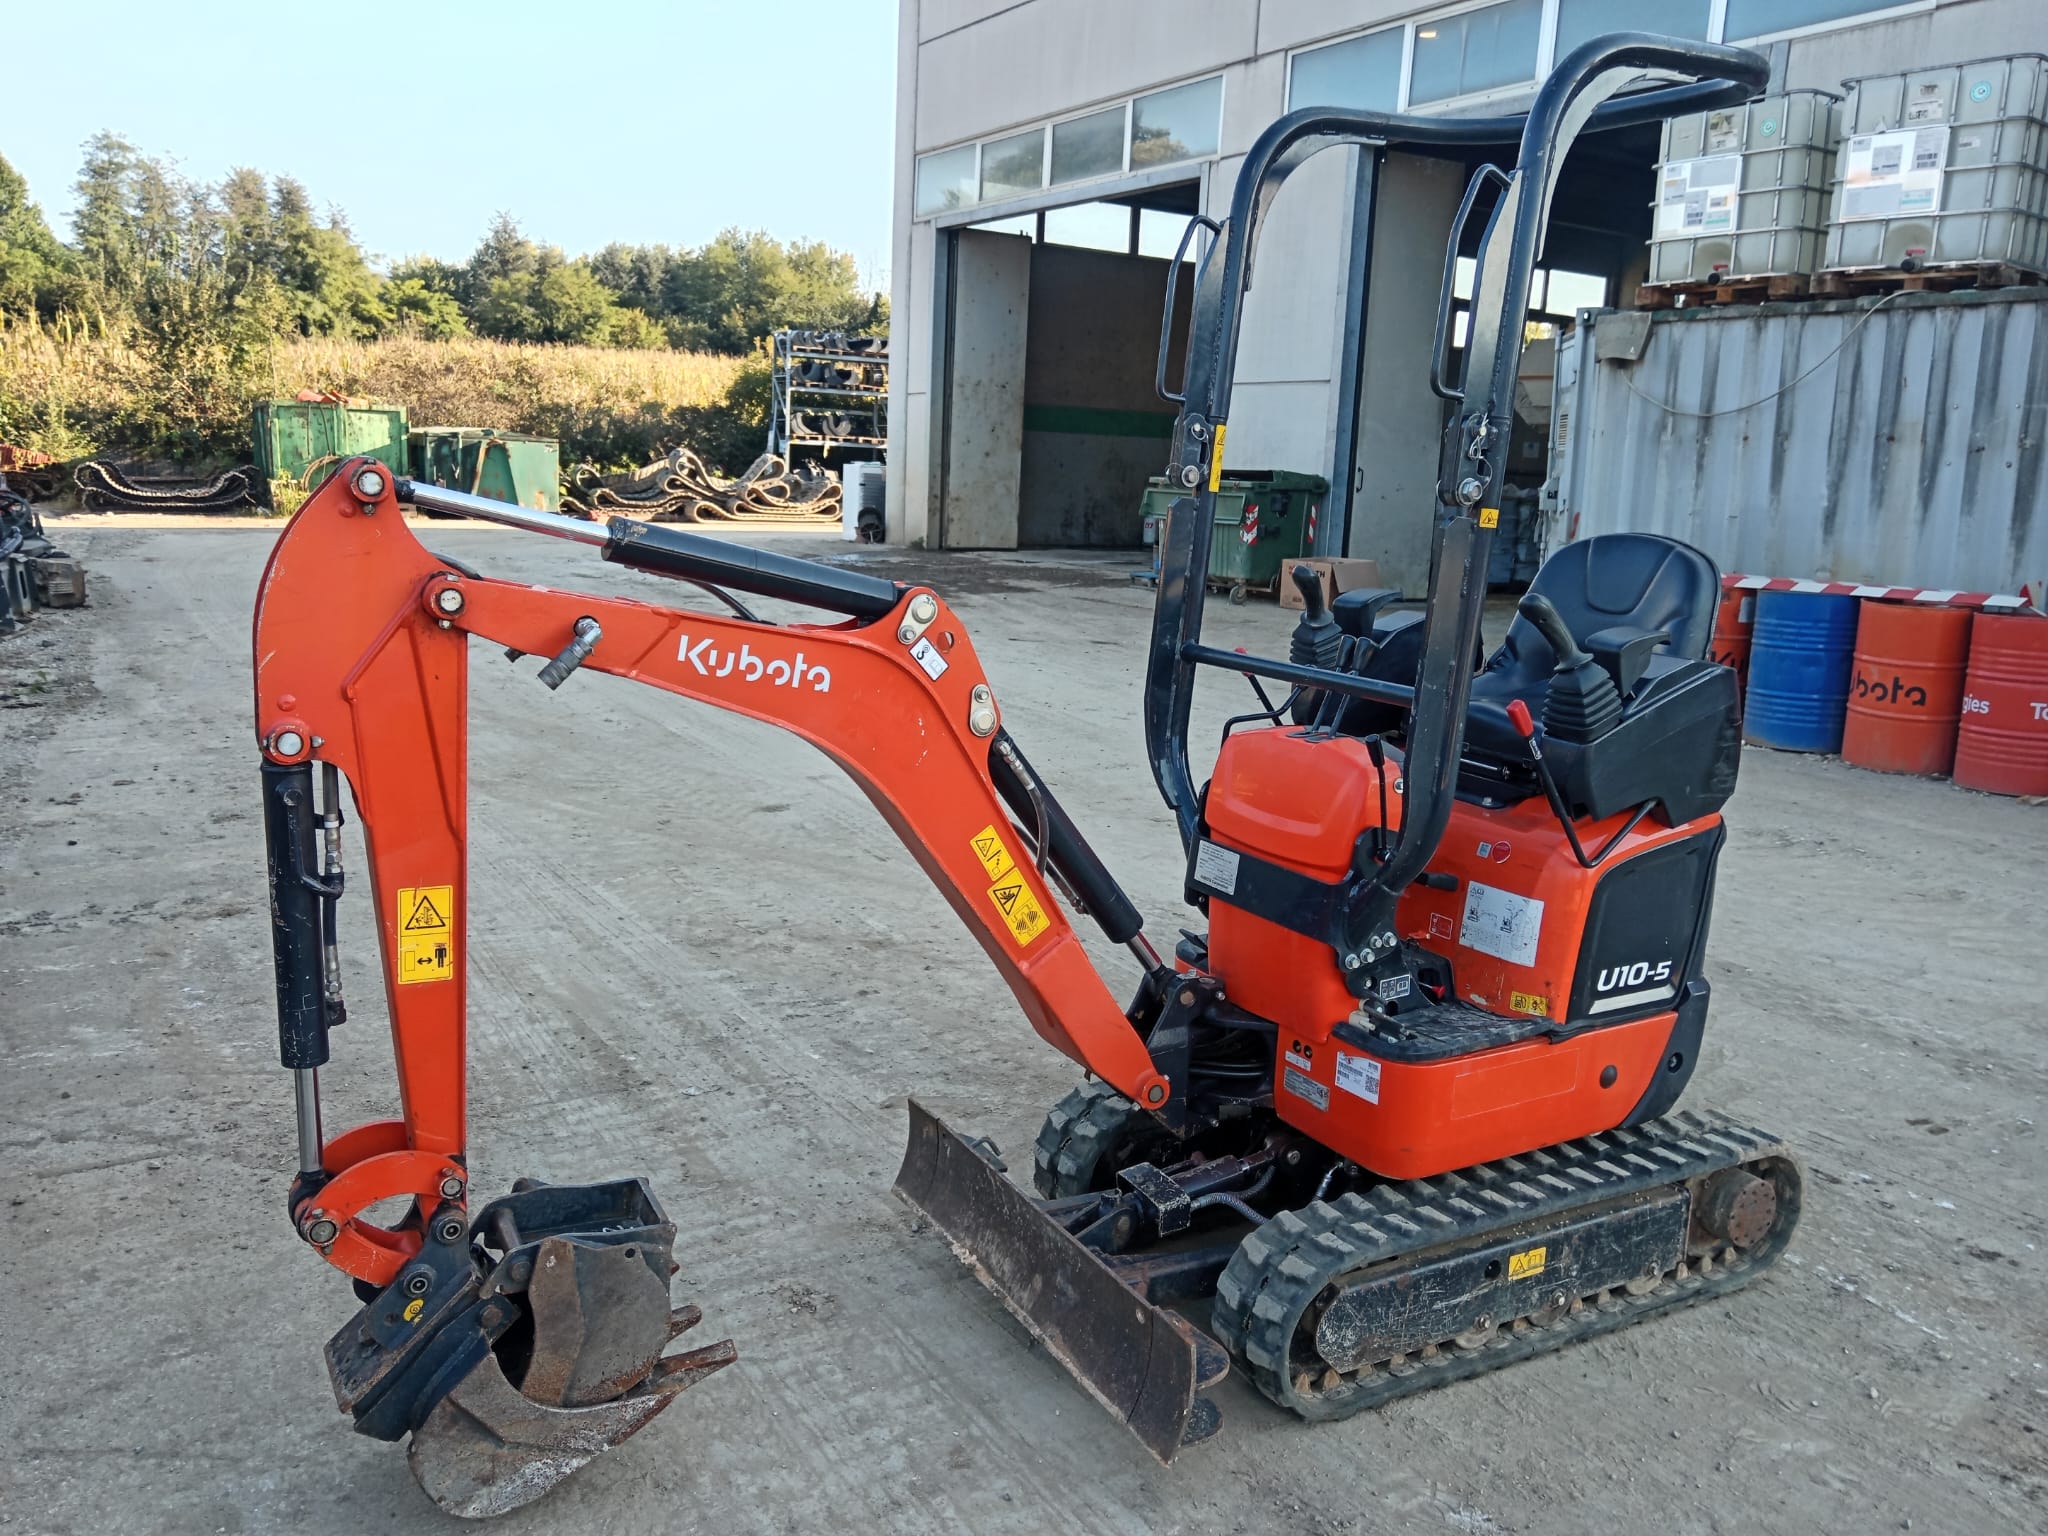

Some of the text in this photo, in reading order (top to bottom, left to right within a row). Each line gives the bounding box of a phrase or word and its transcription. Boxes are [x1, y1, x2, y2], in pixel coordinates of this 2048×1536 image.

[677, 634, 831, 692] Kubota
[1850, 670, 1927, 706] bota
[1597, 960, 1672, 991] U10-5
